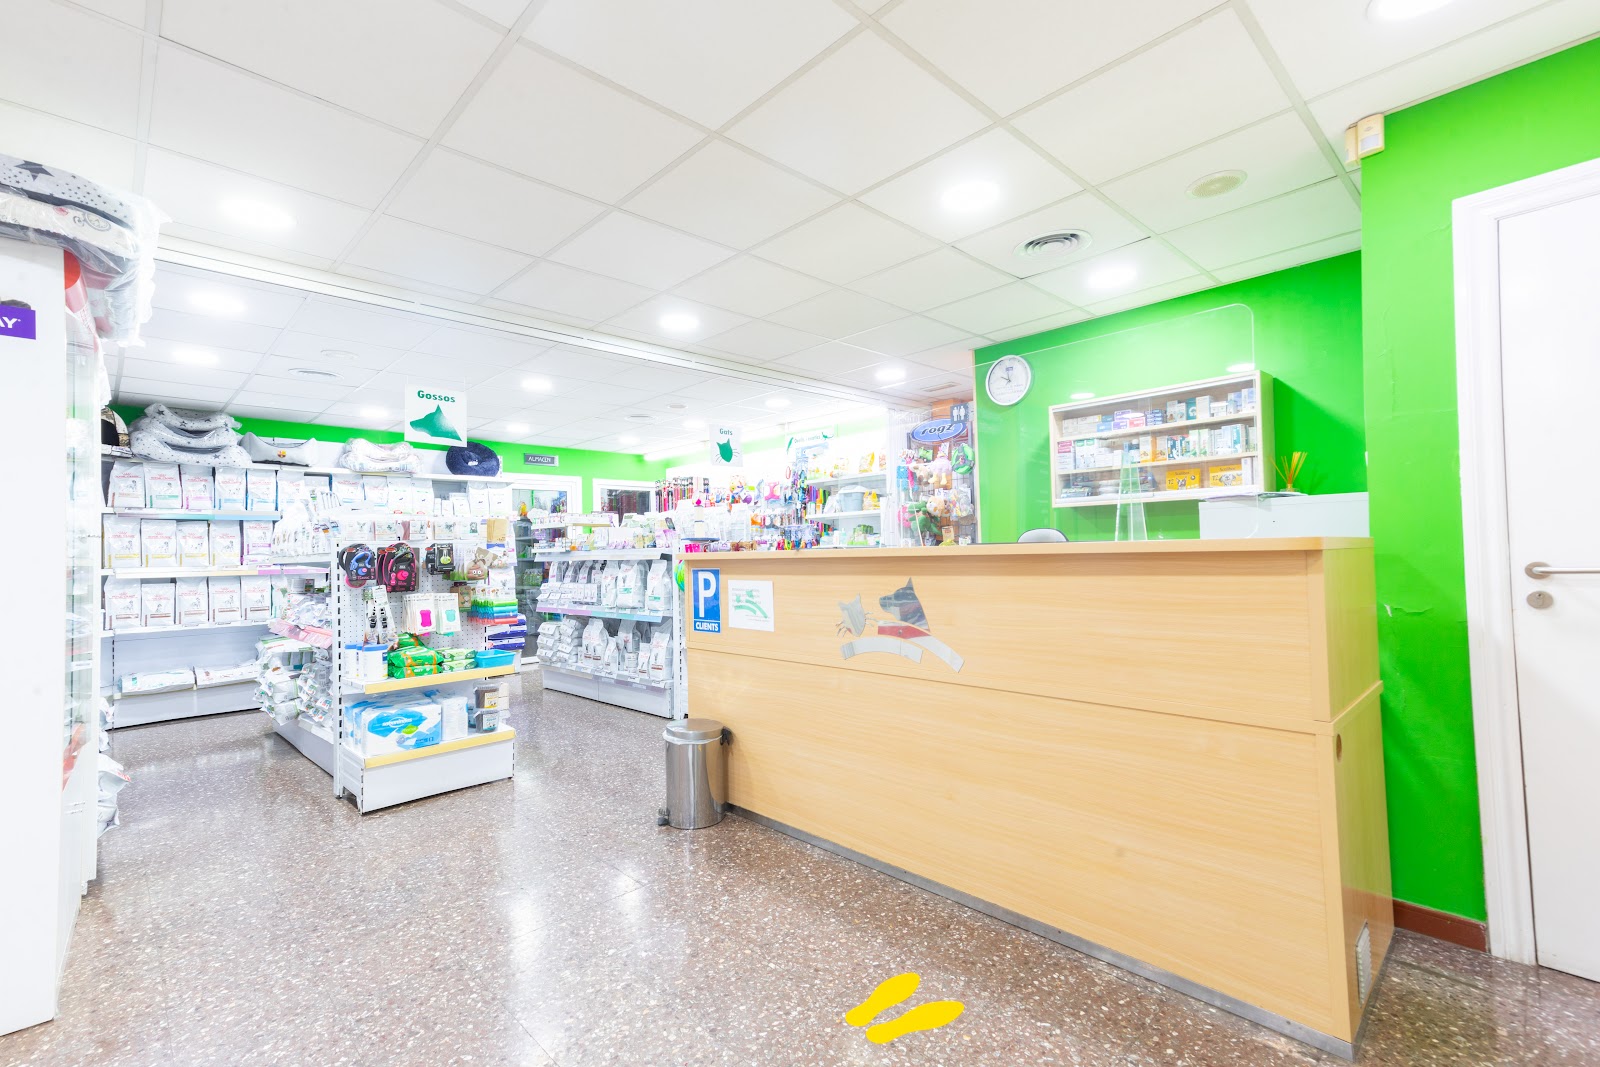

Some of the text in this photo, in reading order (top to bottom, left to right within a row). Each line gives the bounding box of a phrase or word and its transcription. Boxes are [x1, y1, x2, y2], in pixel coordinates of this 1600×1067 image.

[417, 390, 456, 402] Gossos
[720, 428, 733, 436] Gats
[921, 424, 954, 434] rogz
[697, 571, 716, 617] P
[695, 622, 718, 631] CLIENTS
